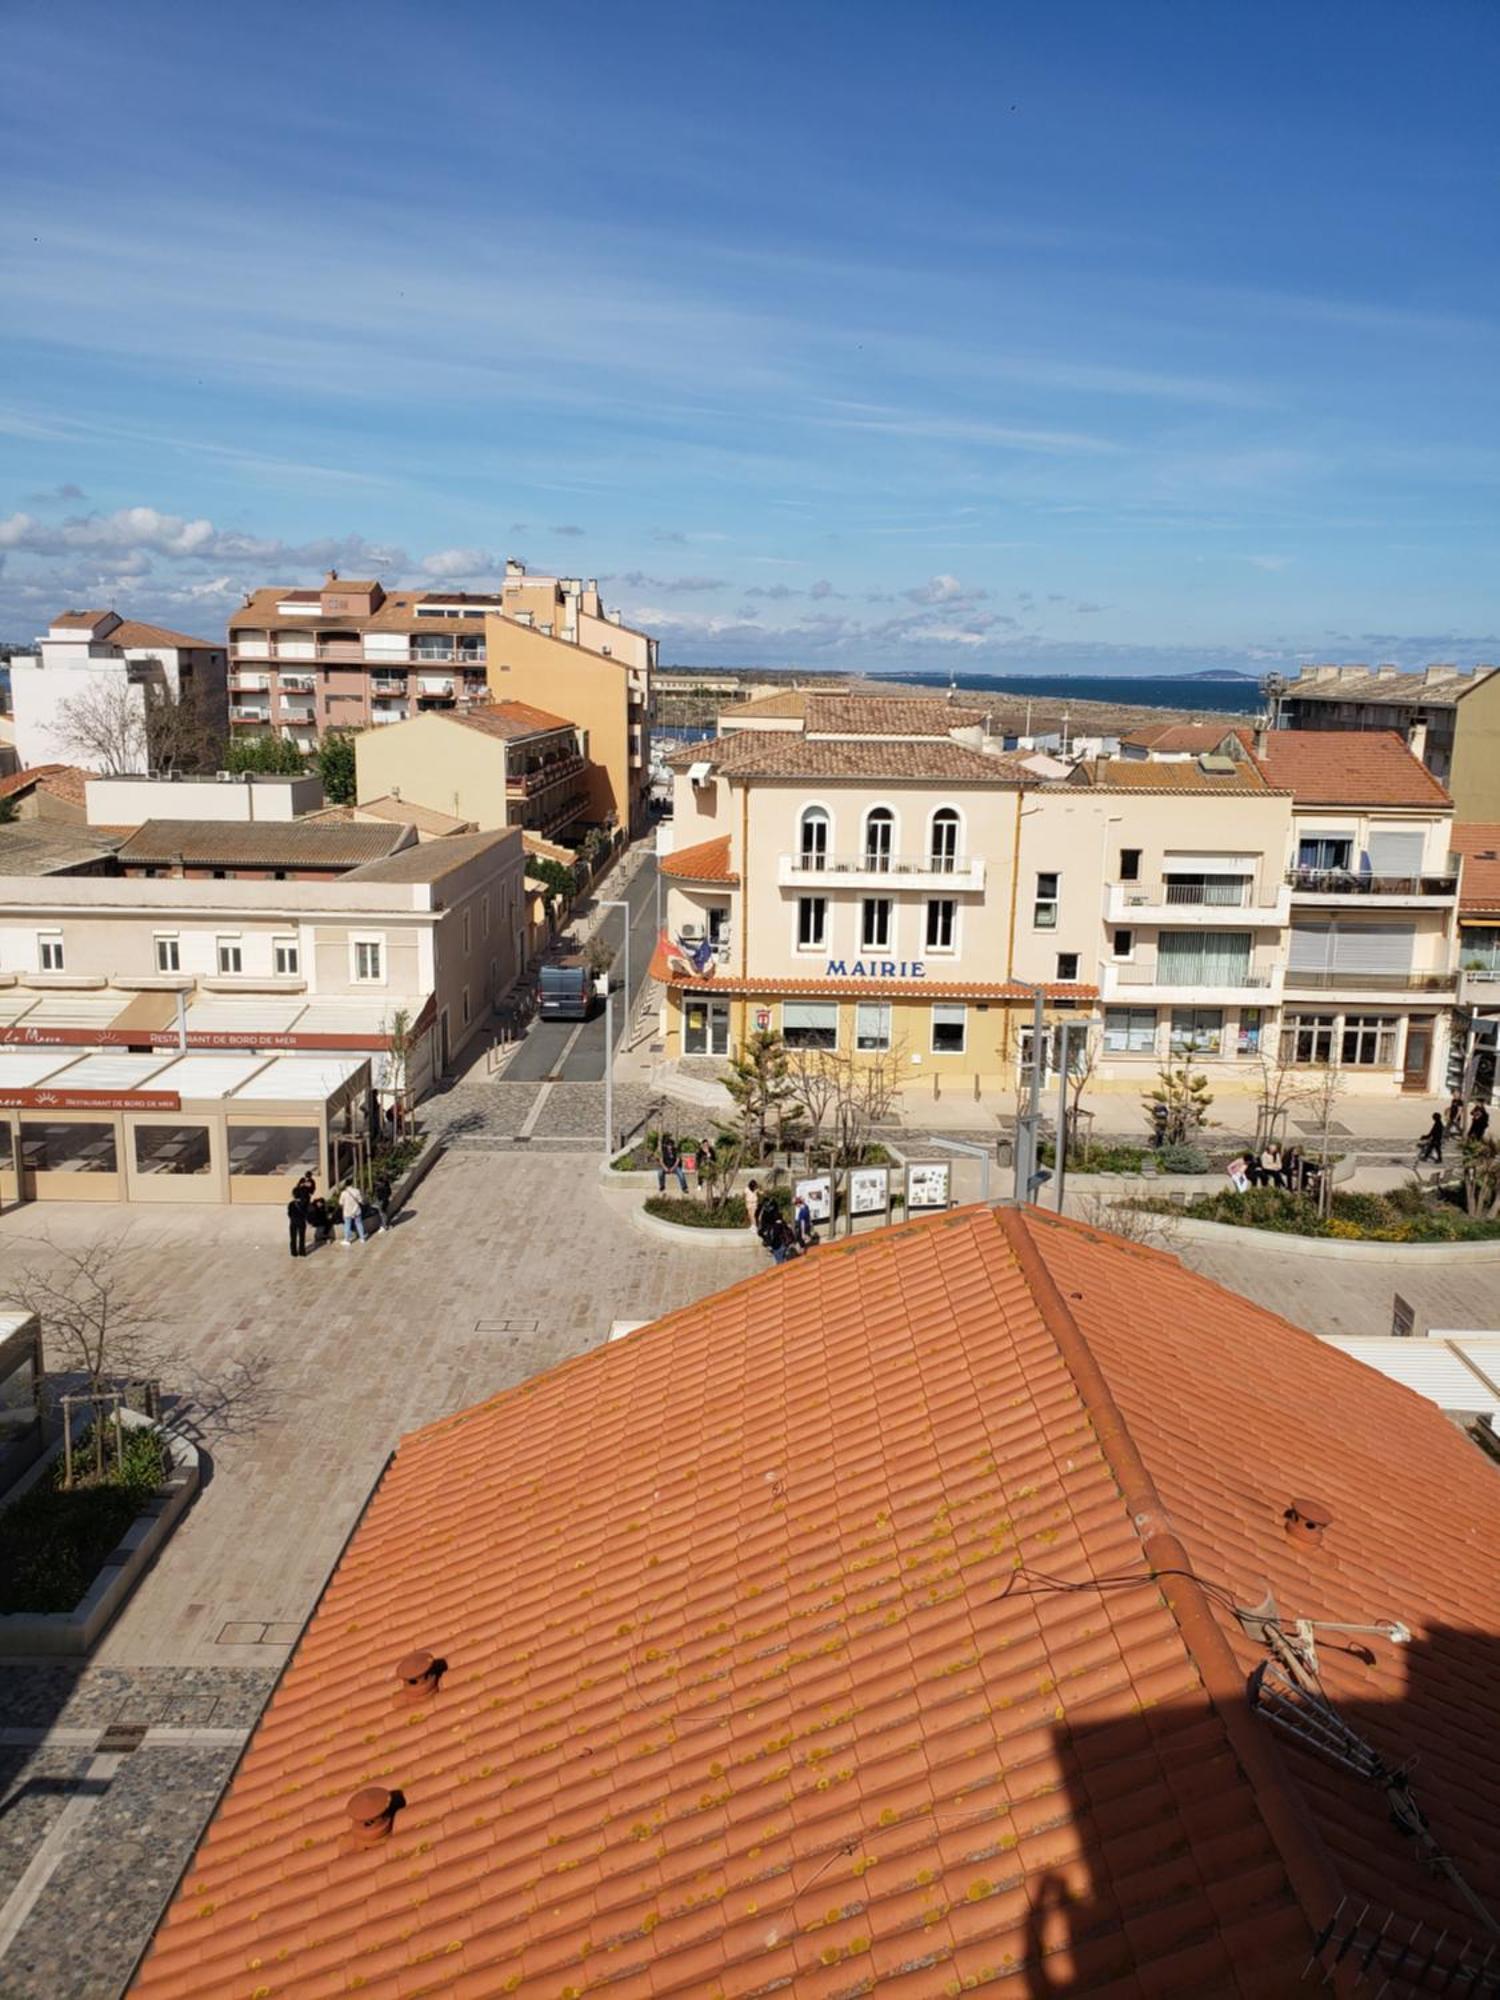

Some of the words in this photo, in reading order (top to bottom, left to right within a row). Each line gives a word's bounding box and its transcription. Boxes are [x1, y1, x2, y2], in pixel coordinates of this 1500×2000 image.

[826, 960, 926, 977] MAIRIE
[213, 1035, 227, 1045] DE
[228, 1035, 257, 1045] BORD
[259, 1036, 273, 1046] DE
